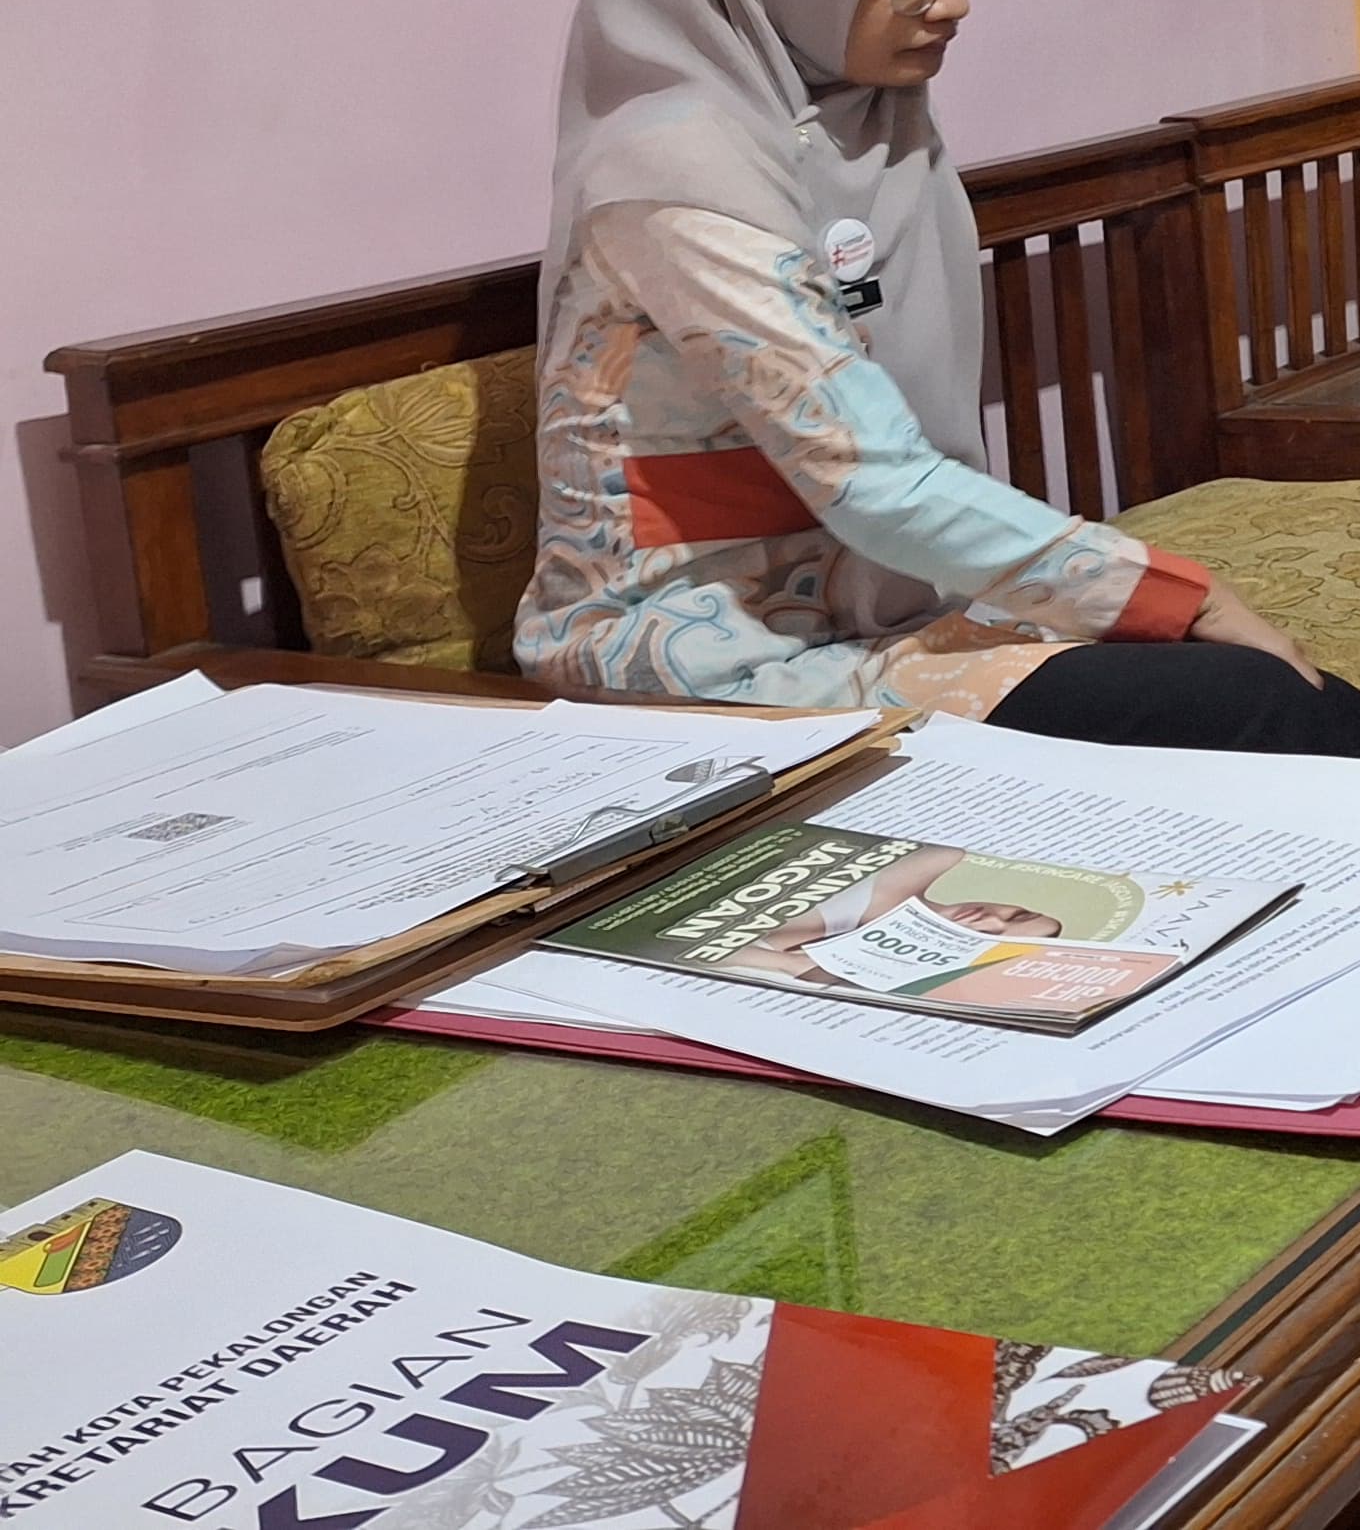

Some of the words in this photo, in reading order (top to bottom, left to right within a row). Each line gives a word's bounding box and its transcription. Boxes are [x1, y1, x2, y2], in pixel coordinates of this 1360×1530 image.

[665, 842, 855, 939] JAGOAN
[684, 840, 920, 962] #SKINCARE
[860, 928, 962, 967] 50.000
[888, 920, 935, 949] SERUM
[1222, 929, 1299, 967] PEKALONGAN
[1003, 958, 1132, 987] VOUCHER
[1182, 970, 1223, 989] TAHUN
[1032, 982, 1106, 1003] GIFT
[239, 1280, 417, 1379] DAERAH
[62, 1392, 161, 1444] KOTA
[158, 1271, 379, 1395] PEKALONGAN
[141, 1307, 533, 1521] BAGIAN
